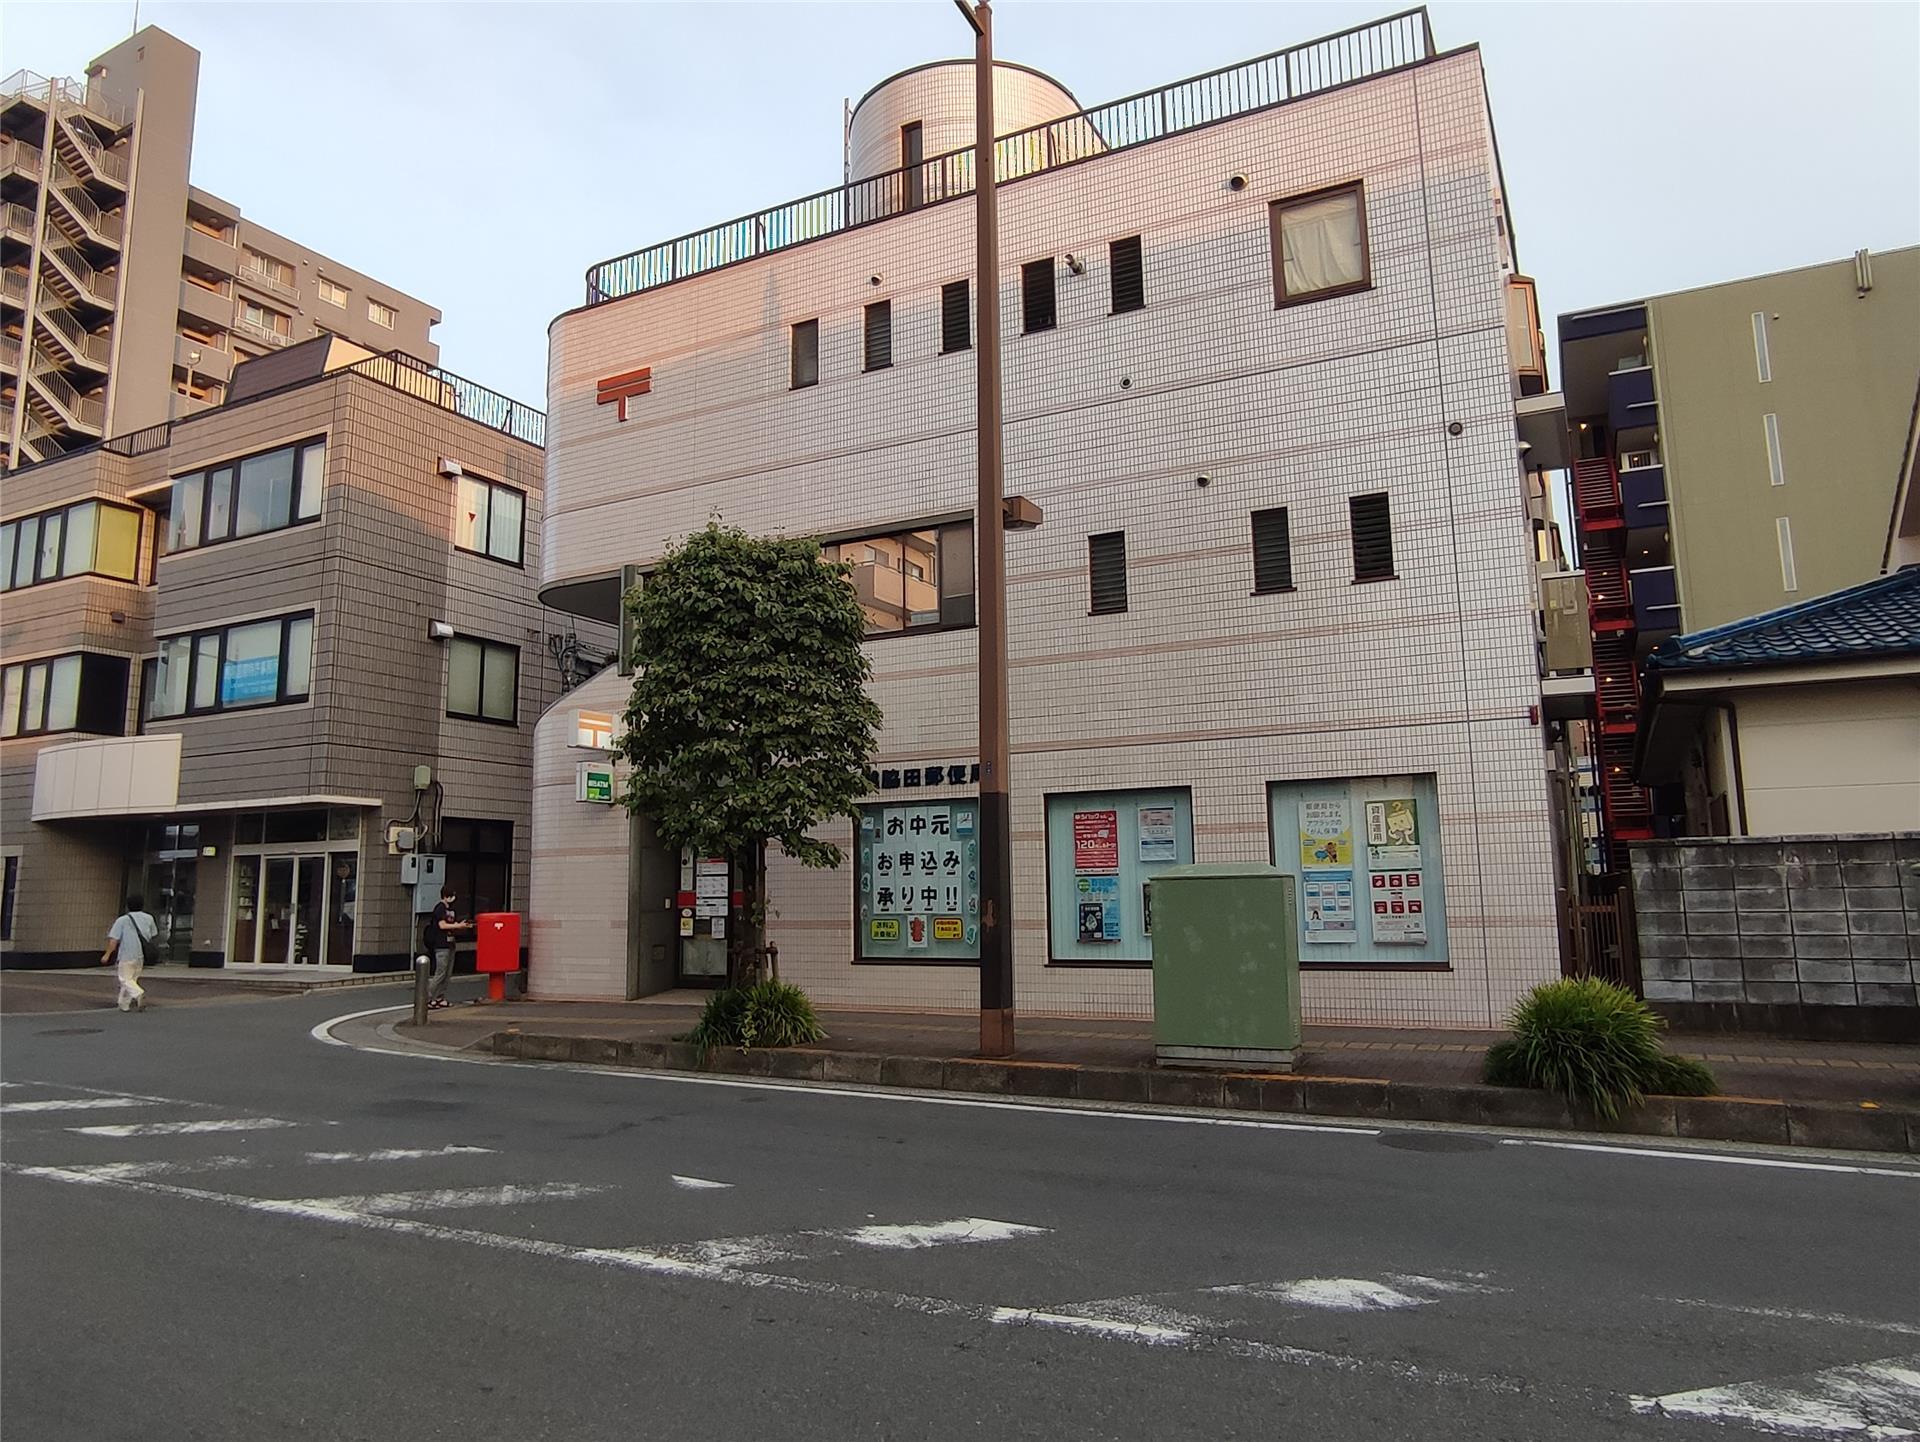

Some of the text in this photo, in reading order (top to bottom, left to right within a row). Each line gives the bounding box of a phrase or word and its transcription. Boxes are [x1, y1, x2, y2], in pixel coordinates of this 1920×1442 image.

[887, 814, 950, 836] お中元
[877, 850, 961, 871] お申込み
[877, 885, 958, 907] 承り中!!
